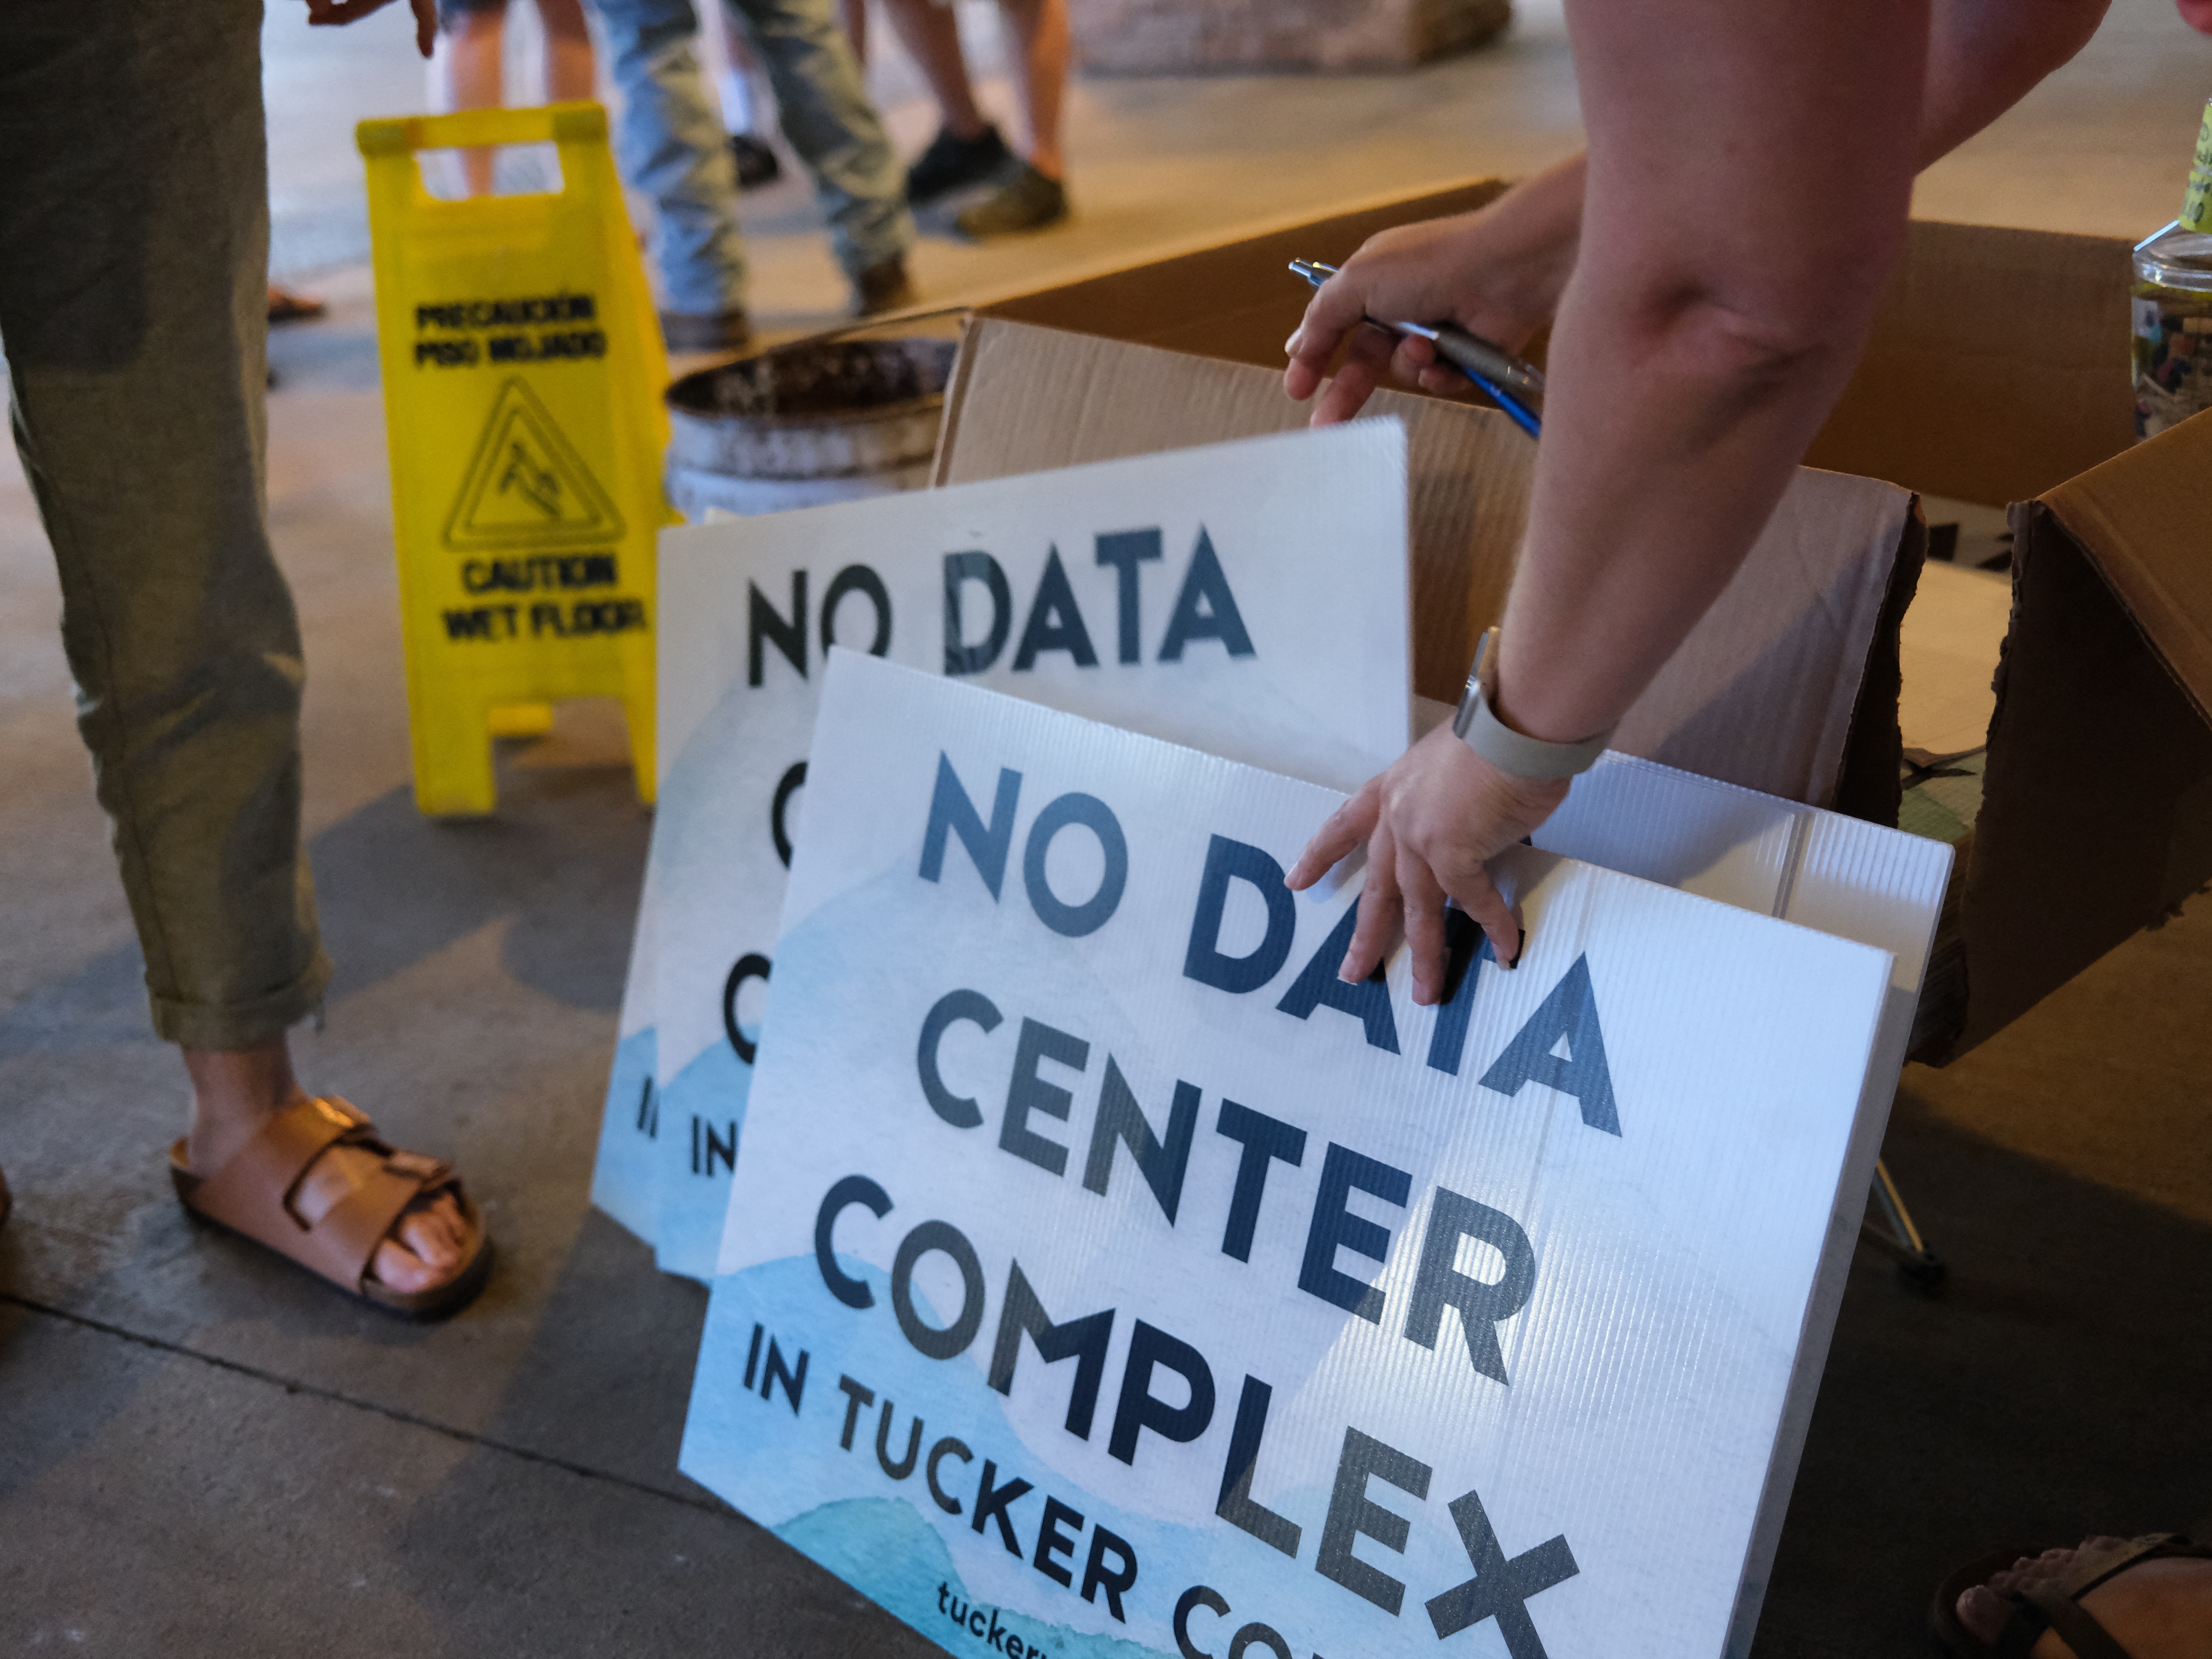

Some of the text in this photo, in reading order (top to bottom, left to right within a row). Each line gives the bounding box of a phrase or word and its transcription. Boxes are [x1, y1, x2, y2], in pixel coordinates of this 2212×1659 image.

[416, 331, 605, 368] PISO MOJADO
[443, 600, 644, 640] WET FLOOR
[463, 554, 619, 593] CAUTION
[748, 523, 1257, 688] NO DATA
[918, 750, 1129, 938] NO
[1183, 833, 1622, 1137] DATA
[692, 1115, 736, 1175] IN
[916, 988, 1536, 1387] CENTER
[743, 1323, 810, 1417] IN
[836, 1374, 1138, 1624] TUCKER
[814, 1174, 1580, 1659] COMPLEX
[938, 1581, 1047, 1659] tucker
